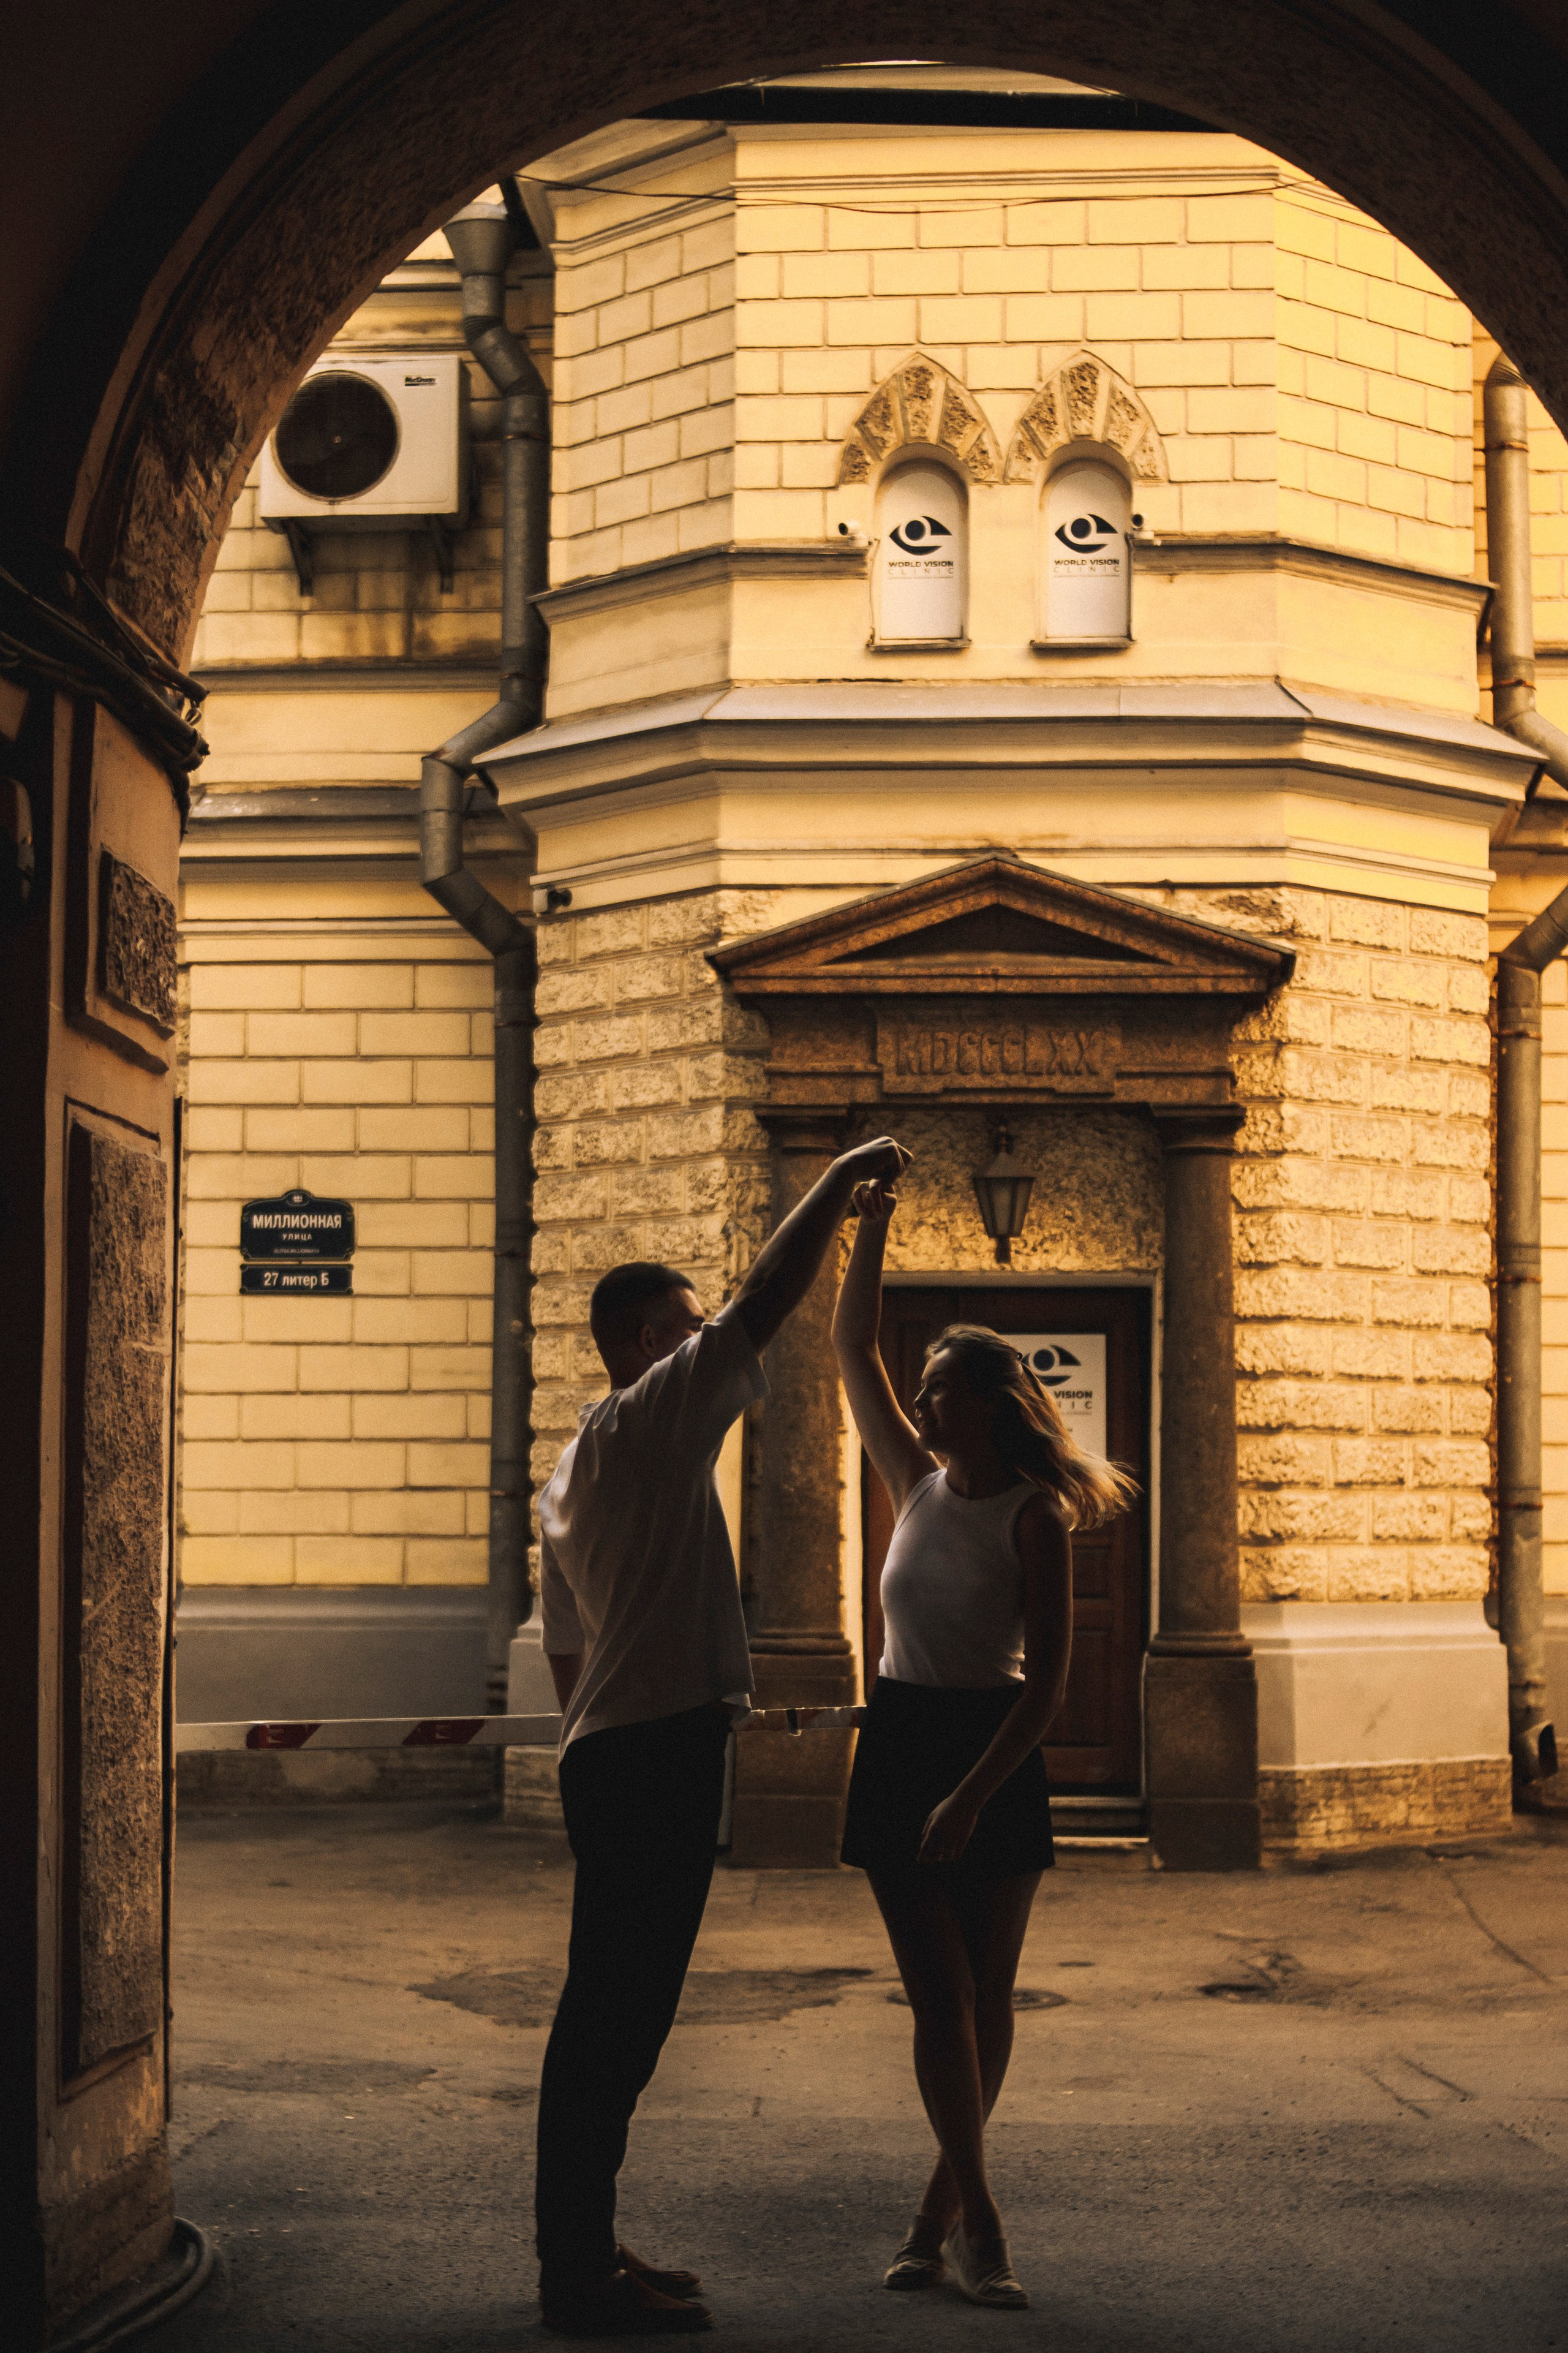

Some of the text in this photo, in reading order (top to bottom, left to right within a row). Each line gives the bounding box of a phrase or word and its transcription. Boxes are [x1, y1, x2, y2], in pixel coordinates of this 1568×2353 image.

[253, 1215, 342, 1228] МИЛЛИОННАЯ
[264, 1272, 329, 1288] 27 литер Б
